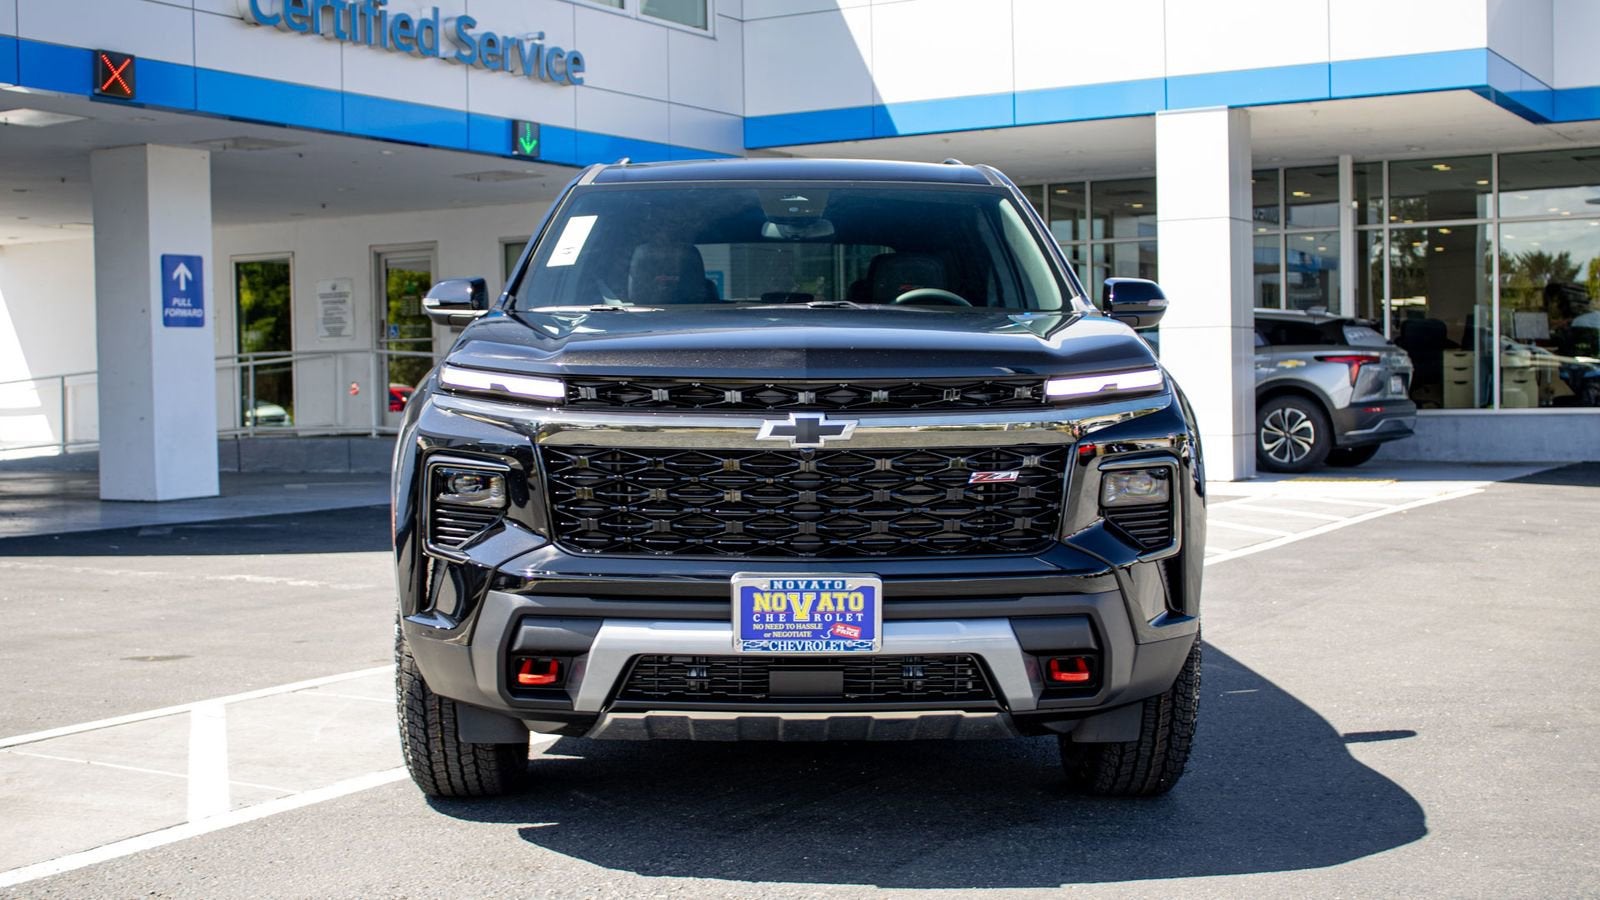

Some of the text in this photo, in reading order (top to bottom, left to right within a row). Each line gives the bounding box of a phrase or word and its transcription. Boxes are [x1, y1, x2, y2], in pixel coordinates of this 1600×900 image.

[455, 15, 586, 86] Service
[172, 297, 192, 307] PULL
[164, 307, 203, 318] FORWARD
[773, 580, 844, 589] NOVATO
[752, 592, 865, 622] NOVATO
[835, 628, 860, 638] PRICE
[768, 640, 846, 651] CHEVROLET
